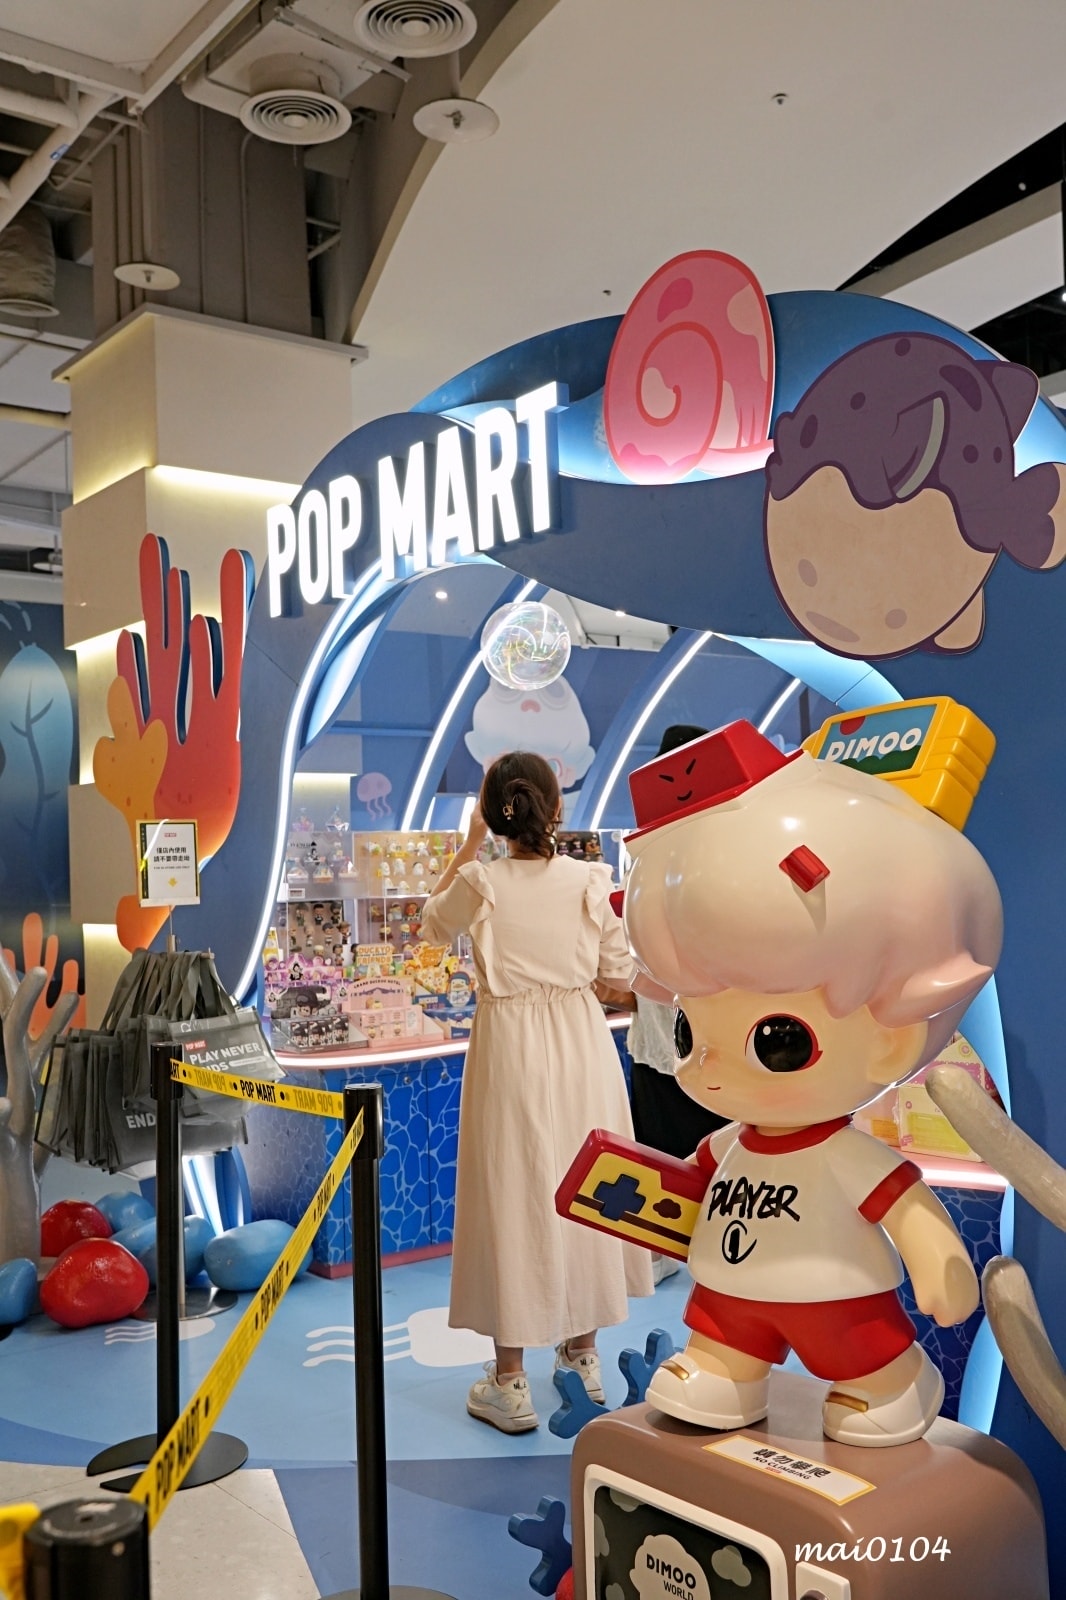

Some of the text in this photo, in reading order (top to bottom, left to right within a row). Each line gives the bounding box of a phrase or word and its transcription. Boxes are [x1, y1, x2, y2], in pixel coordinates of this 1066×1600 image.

[266, 380, 562, 618] POP MART
[824, 727, 922, 762] DIMOO
[189, 1050, 219, 1065] PLAY
[220, 1042, 261, 1058] NEVER
[170, 1062, 180, 1079] ART
[239, 1079, 277, 1103] POP MART
[126, 1112, 157, 1129] END
[707, 1176, 800, 1222] PLAYER
[155, 1398, 201, 1514] POP MART
[752, 1456, 768, 1464] NO
[767, 1461, 812, 1480] CLIMBING
[753, 1448, 832, 1478] 請勿攀爬
[646, 1553, 697, 1589] DIMOO
[663, 1580, 694, 1600] WORLD
